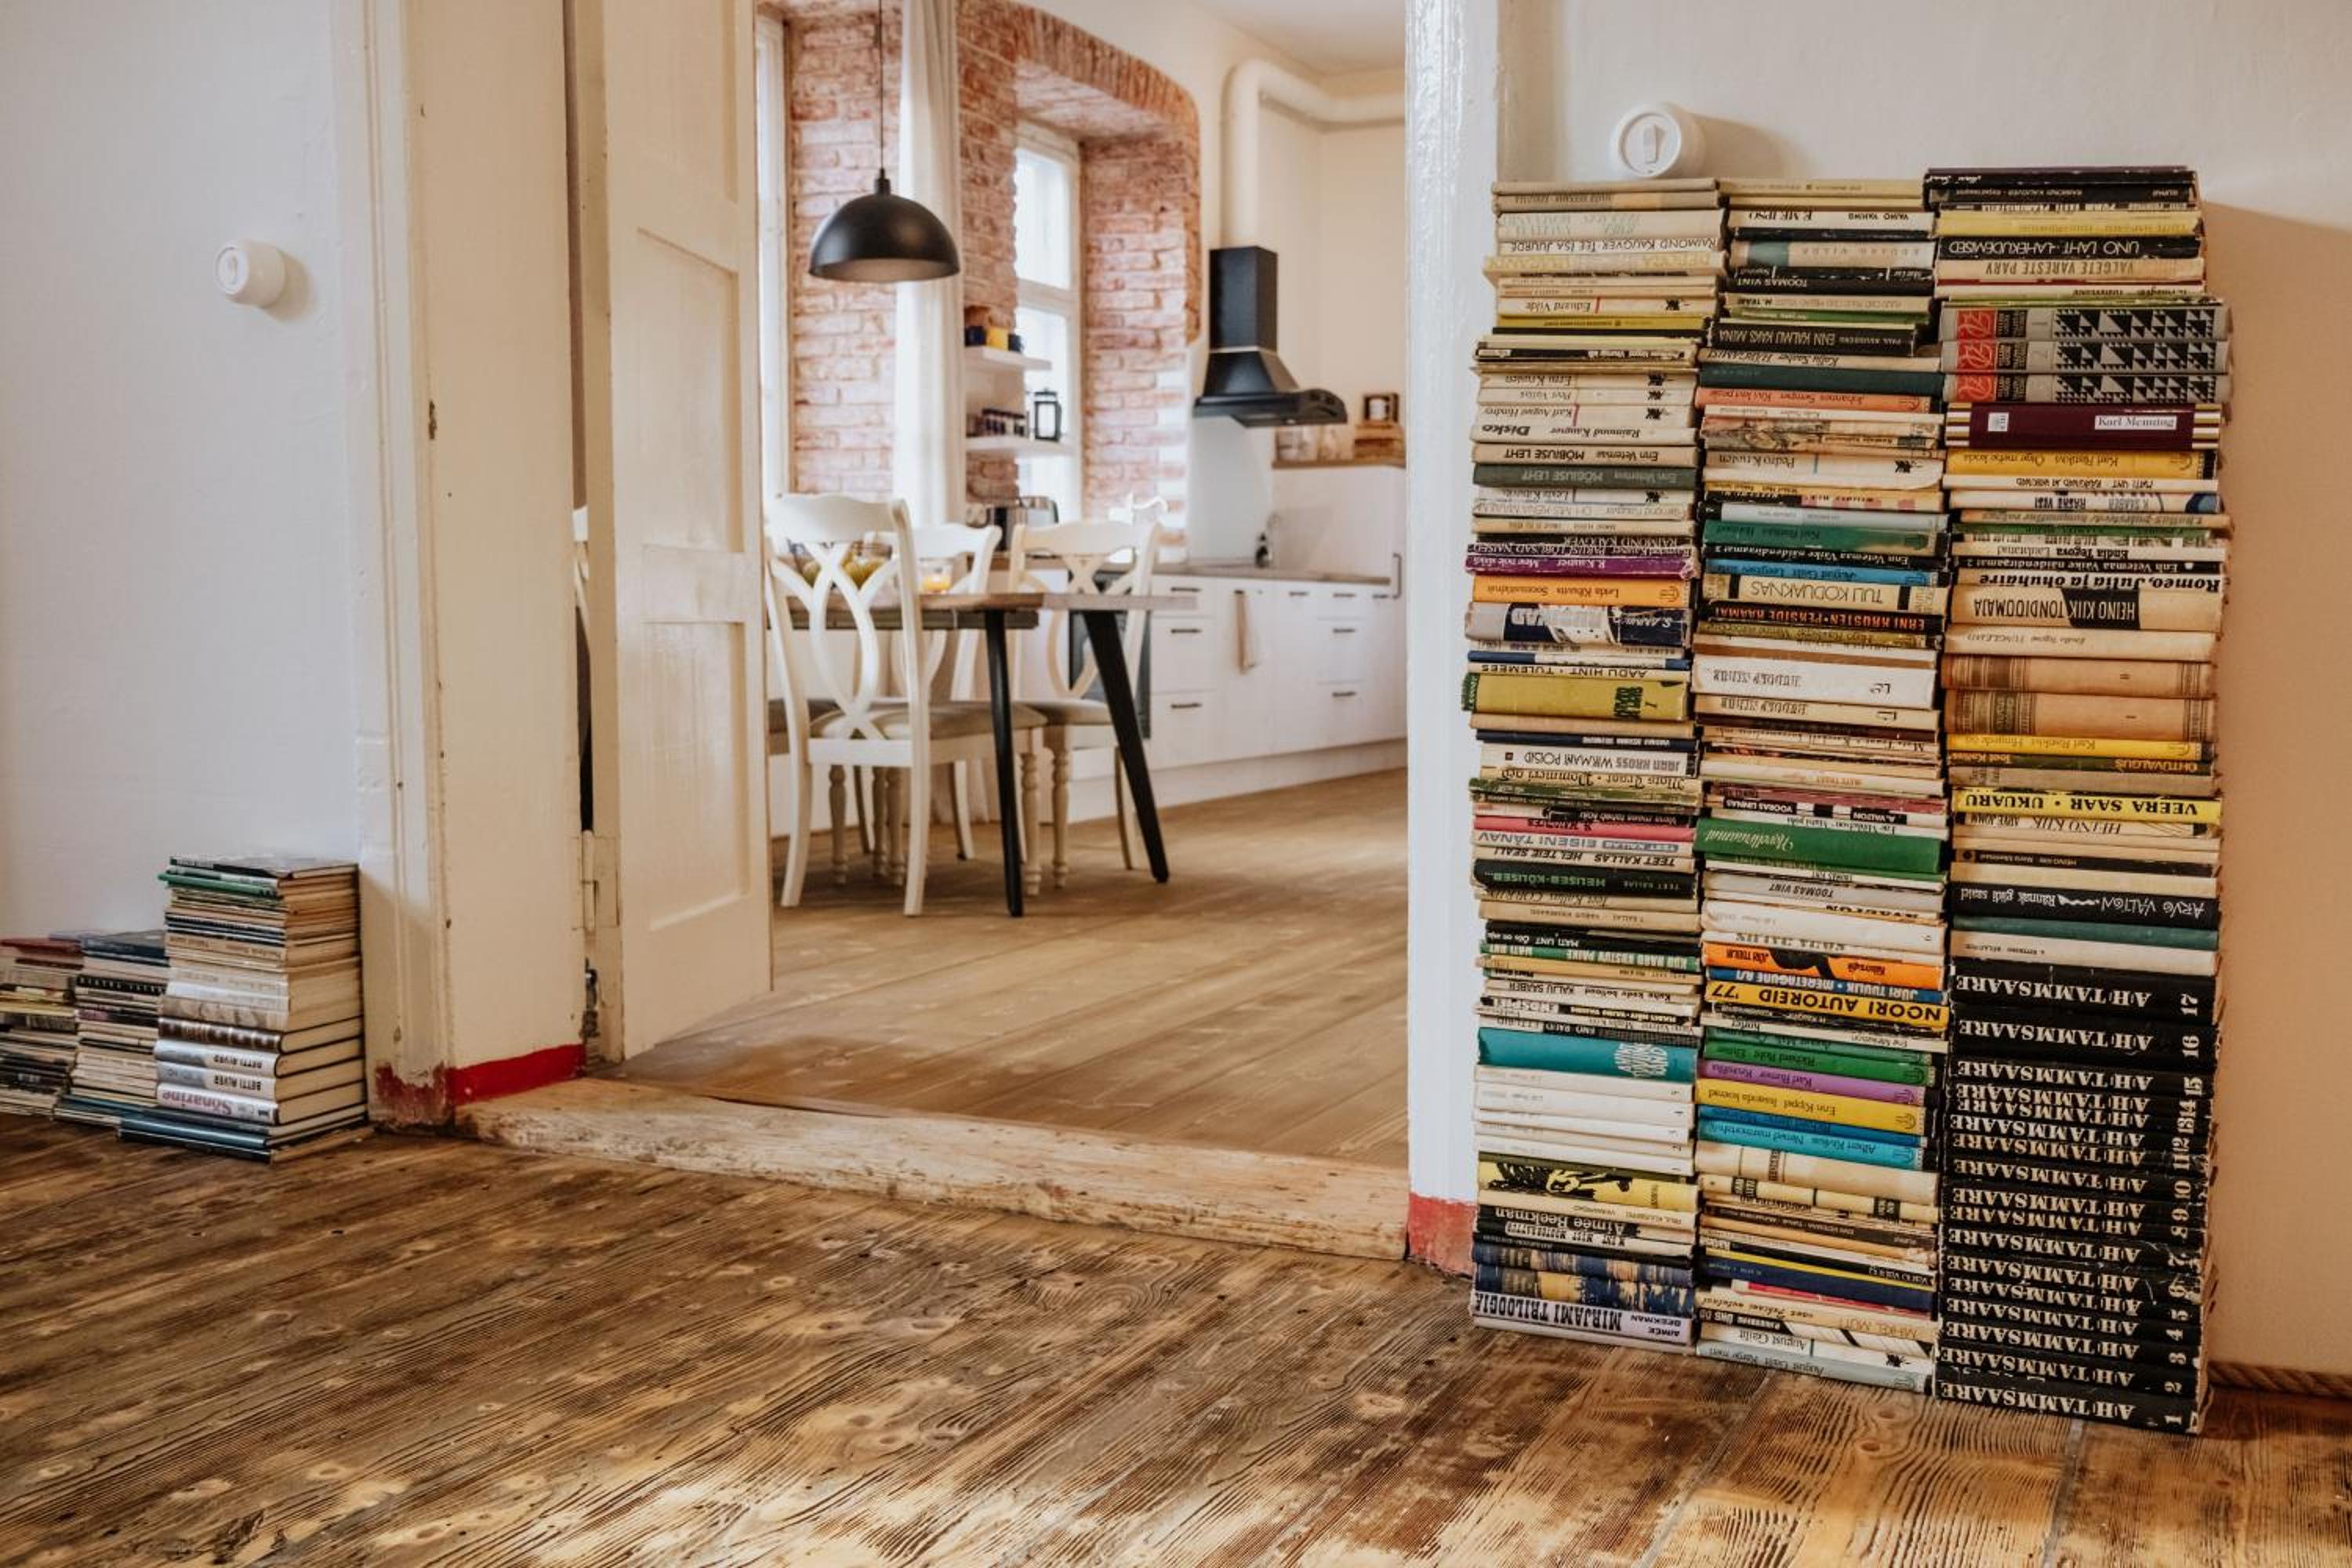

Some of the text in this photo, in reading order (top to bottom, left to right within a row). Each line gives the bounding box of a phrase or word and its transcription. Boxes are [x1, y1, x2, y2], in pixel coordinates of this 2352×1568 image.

[1602, 239, 1654, 250] KAUGVER
[1659, 238, 1716, 249] RAIMOND
[1949, 241, 2139, 254] UNO LAHT LAHEKUDEMISED
[1985, 261, 2134, 275] VALGETE VARESTE PARV
[1764, 278, 1807, 287] TOOMAS
[1526, 301, 1591, 312] Eduard Vilde
[1719, 330, 1748, 341] MINA
[1749, 331, 1774, 342] KAKS
[1813, 333, 1835, 344] ENN
[2099, 417, 2175, 427] Karl Menning
[1482, 425, 1530, 436] Disko
[1594, 428, 1640, 438] Raimond
[1503, 448, 1531, 459] LEHT
[1534, 449, 1584, 460] MÖBIUSE
[1639, 451, 1658, 461] Enn
[1719, 455, 1795, 468] Pedro Krusten
[2096, 456, 2118, 466] Karl
[1521, 470, 1550, 481] LEHT
[1554, 471, 1603, 482] MÖBIUSE
[1620, 537, 1677, 546] RAIMOND
[1722, 546, 1806, 558] näidendiraamat
[1807, 550, 1837, 561] Väike
[1839, 552, 1884, 563] Vetemaa
[2056, 546, 2129, 559] Endla Tegova
[1887, 556, 1908, 564] Enn
[1976, 559, 2065, 569] näidendiraamat
[2067, 561, 2098, 570] Väike
[2102, 561, 2151, 571] Vetemaa
[2154, 563, 2178, 572] Enn
[1979, 574, 2221, 592] Romeo, Julia ja õhuhäire
[1751, 581, 1882, 604] TULI KODUAKNAS
[1973, 598, 2135, 619] HEINO KIIK TONDIÖÖMAJA
[1831, 614, 1890, 626] KRUSTEN
[1893, 618, 1925, 630] ERNI
[1483, 664, 1647, 678] AADU HINT TULEMEES
[1752, 673, 1802, 686] RUDOLF
[1563, 755, 1613, 771] WIKMANI
[1616, 757, 1650, 771] KROSS
[1726, 799, 1757, 811] LINNAS
[1965, 795, 2198, 815] VEERA SAAR UKUARU
[2032, 817, 2065, 832] KIIK
[2067, 820, 2122, 835] HEINO
[1478, 832, 1534, 846] TÄNAV
[1538, 836, 1597, 847] EISENI
[1531, 850, 1557, 858] TEIE
[1595, 854, 1642, 866] KALLAS
[1643, 857, 1675, 866] TEET
[1769, 884, 1834, 898] TOOMAS VINT
[1756, 971, 1834, 990] MERETAGUNE
[1509, 982, 1544, 994] SAABER
[1847, 982, 1886, 996] TUULIK
[1888, 989, 1918, 1000] JÜRI
[1955, 975, 2106, 1004] TAMMSAARE
[1711, 984, 1941, 1022] NOORI AUTOREID '77
[1958, 1019, 2107, 1047] TAMMSAARE
[1957, 1061, 2107, 1087] TAMMSAARE
[1791, 1076, 1812, 1088] Karl
[1956, 1083, 2107, 1108] TAMMSAARE
[162, 1091, 232, 1116] Sõnarine
[1815, 1106, 1835, 1116] Enn
[1956, 1098, 2106, 1124] TAMMSAARE
[1950, 1115, 2100, 1144] TAMMSAARE
[1951, 1133, 2100, 1163] TAMMSAARE
[1954, 1159, 2103, 1189] TAMMSAARE
[1952, 1187, 2101, 1214] TAMMSAARE
[1495, 1207, 1568, 1231] Beekman
[1949, 1206, 2099, 1232] TAMMSAARE
[1573, 1217, 1625, 1236] Aimée
[1947, 1228, 2097, 1259] TAMMSAARE
[1947, 1254, 2094, 1287] TAMMSAARE
[1948, 1277, 2097, 1309] TAMMSAARE
[1474, 1293, 1622, 1332] MIRJAMI TRILOOGIA
[1946, 1298, 2094, 1330] TAMMSAARE
[1630, 1315, 1681, 1327] BEEKMAN
[1648, 1327, 1680, 1337] AIMEE
[1945, 1321, 2094, 1354] TAMMSAARE
[1739, 1329, 1807, 1352] August Gailit
[1935, 1348, 2090, 1381] TAMMSAARE
[1940, 1383, 2090, 1415] TAMMSAARE
